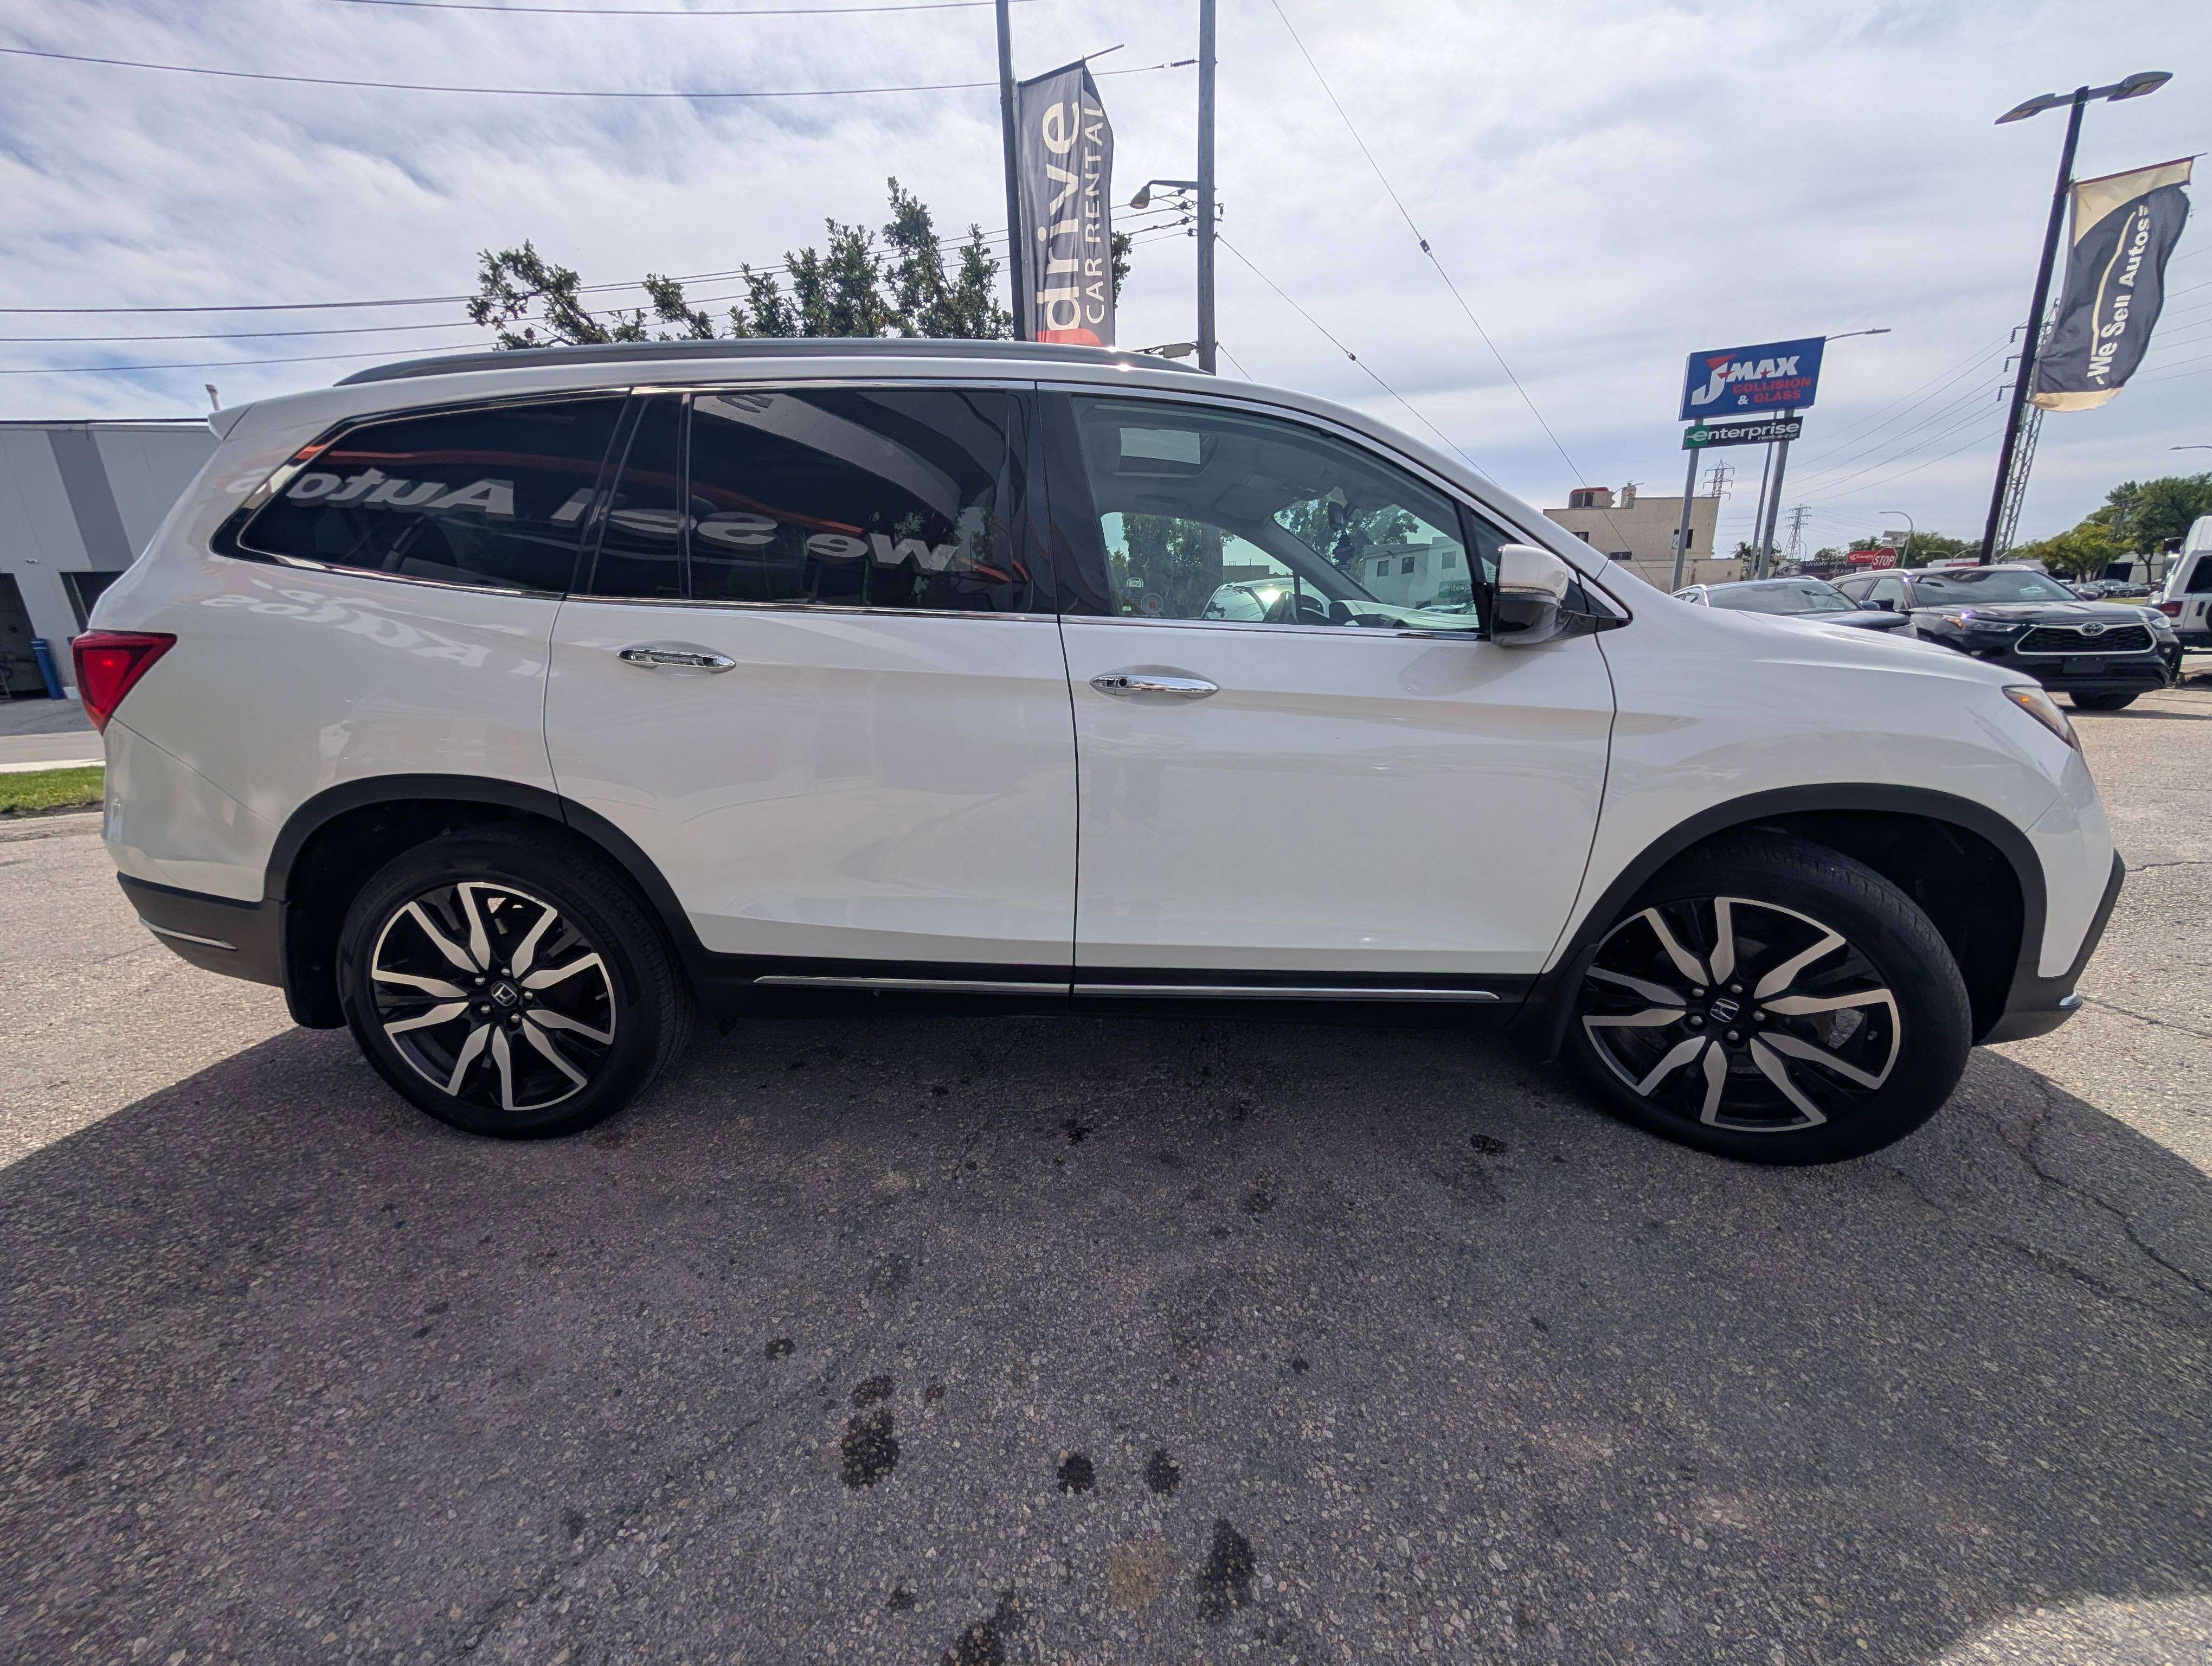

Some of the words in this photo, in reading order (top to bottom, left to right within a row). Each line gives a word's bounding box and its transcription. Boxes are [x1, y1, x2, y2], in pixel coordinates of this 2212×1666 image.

[1084, 107, 1104, 244] RENTAL
[1037, 101, 1079, 331] drive
[2119, 217, 2151, 287] Autos
[1084, 258, 1105, 324] CAR
[2101, 294, 2132, 337] Sell
[2087, 342, 2117, 377] We
[1732, 377, 1811, 395] COLLISION
[1738, 395, 1749, 405] &
[1753, 389, 1801, 403] GLASS
[1687, 422, 1800, 442] enterprise
[1873, 555, 1895, 566] STOP
